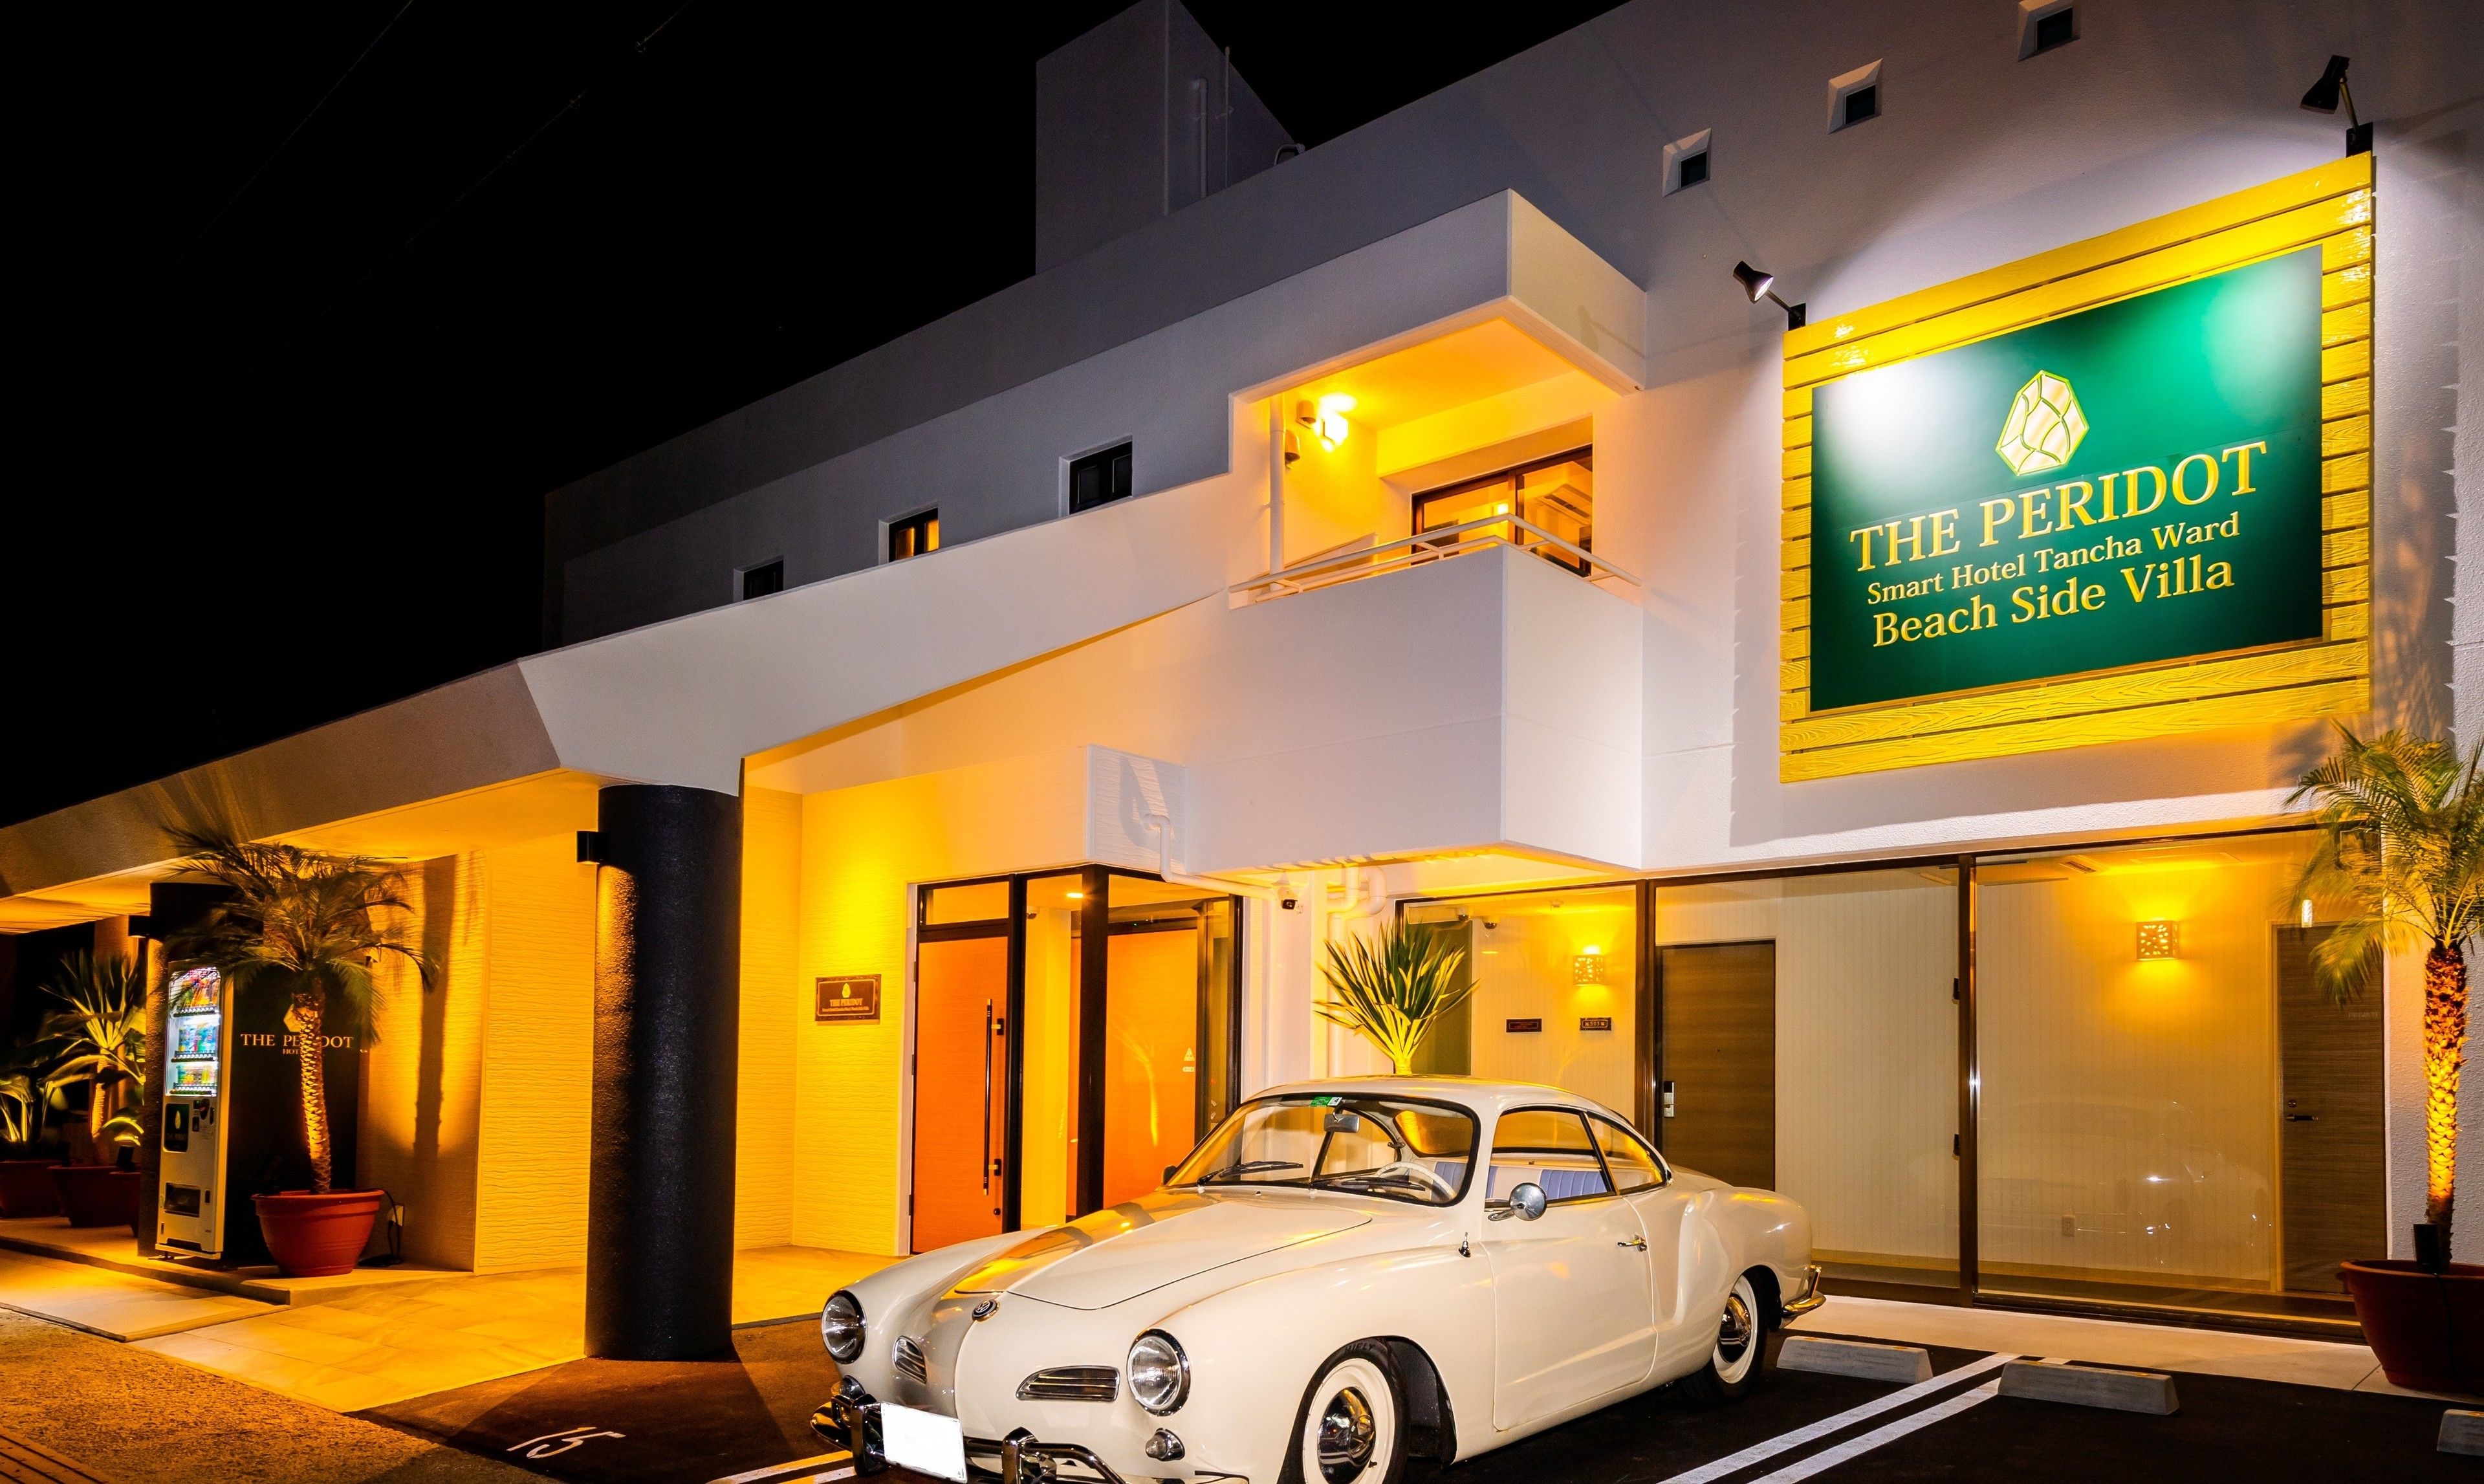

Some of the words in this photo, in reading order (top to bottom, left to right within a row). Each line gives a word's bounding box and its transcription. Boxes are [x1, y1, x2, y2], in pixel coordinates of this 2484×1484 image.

[1849, 508, 1961, 572] THE
[1979, 441, 2267, 548] PERIDOT
[1867, 572, 1945, 606] Smart
[1951, 554, 2026, 589] Hotel
[2034, 535, 2143, 574] Tancha
[2152, 511, 2241, 551] Ward
[1873, 595, 1998, 648] Beach
[2010, 576, 2107, 624] Side
[2120, 554, 2236, 603] Villa
[240, 1034, 276, 1047] THE
[283, 1034, 354, 1048] PEDOT
[506, 1426, 627, 1459] 15
